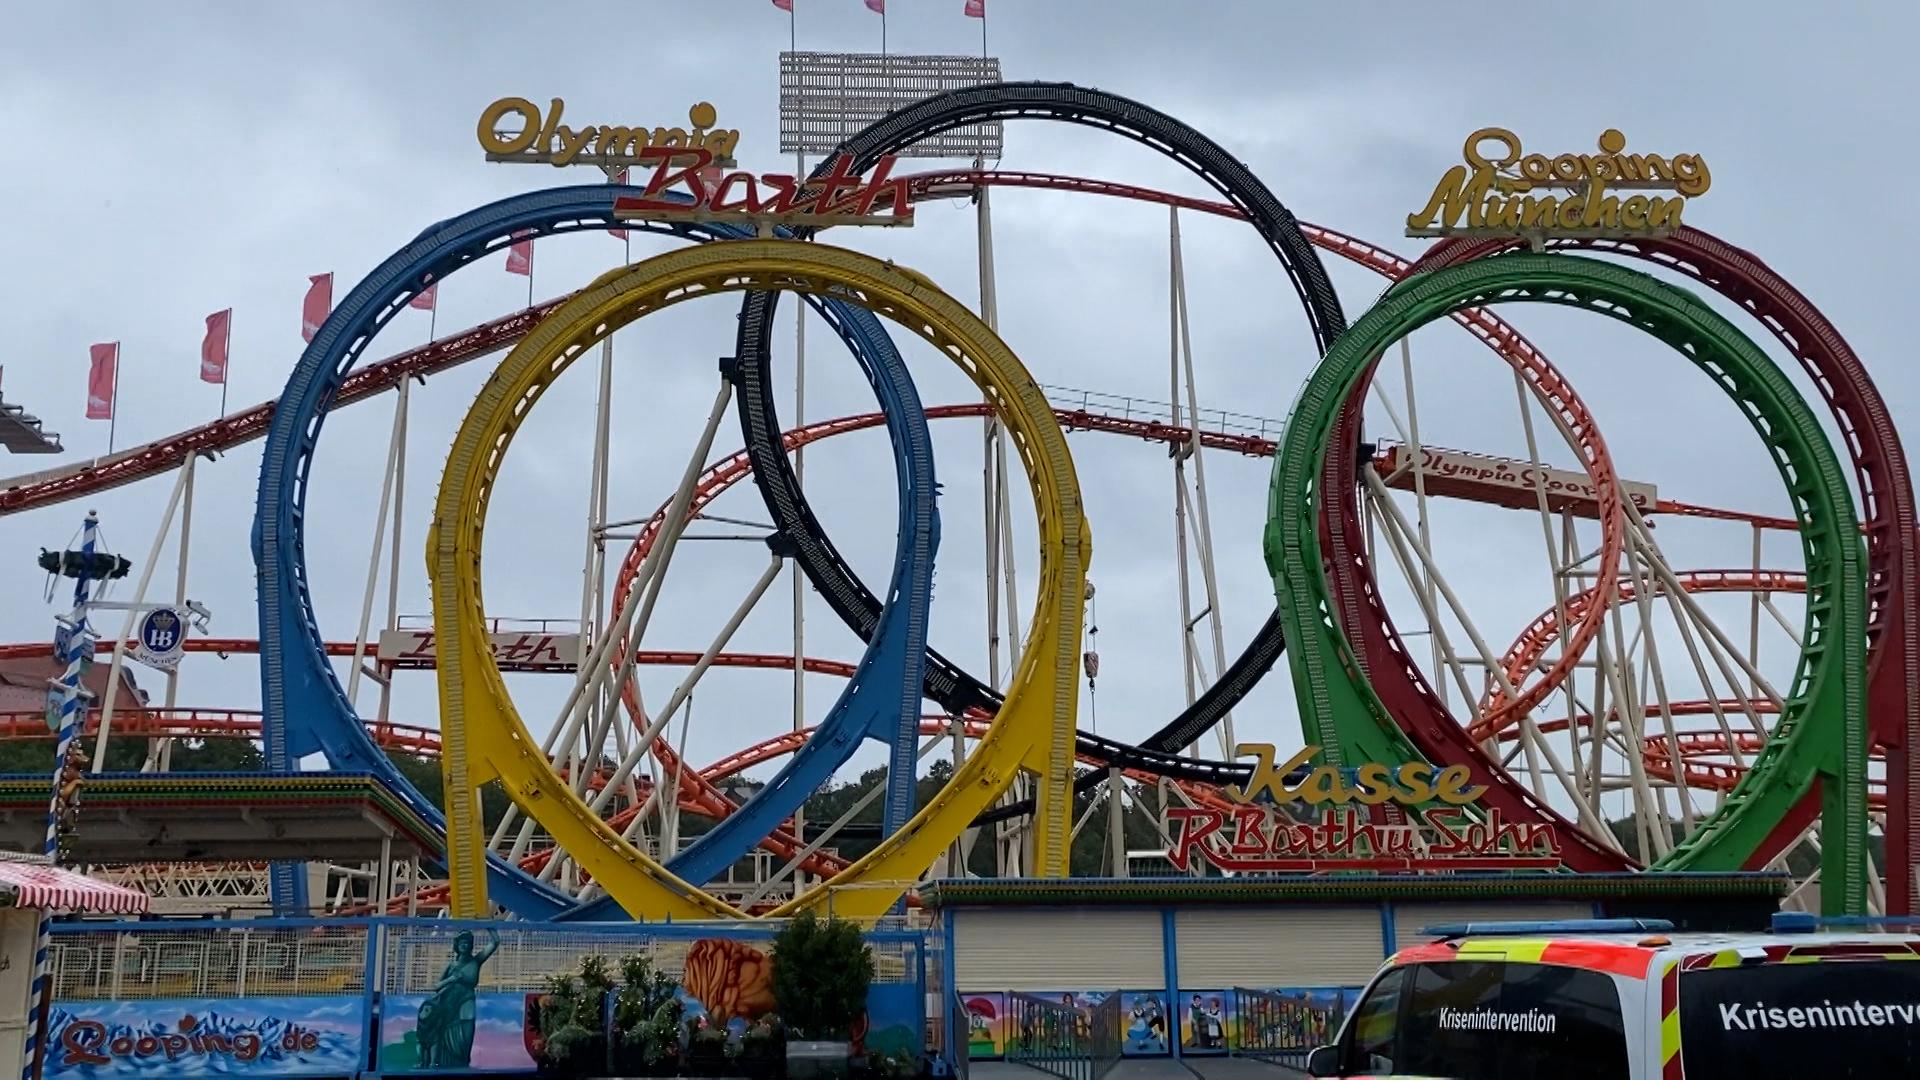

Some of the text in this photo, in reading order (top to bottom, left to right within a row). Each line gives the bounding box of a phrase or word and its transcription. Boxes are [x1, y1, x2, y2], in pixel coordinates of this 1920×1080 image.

[477, 97, 740, 168] Olympia
[1463, 127, 1711, 197] Looping
[614, 146, 915, 217] Barth
[1226, 742, 1490, 805] Kasse
[1420, 806, 1562, 856] Sohn
[61, 1012, 262, 1065] Looping
[1438, 1006, 1557, 1034] Krisenintervention
